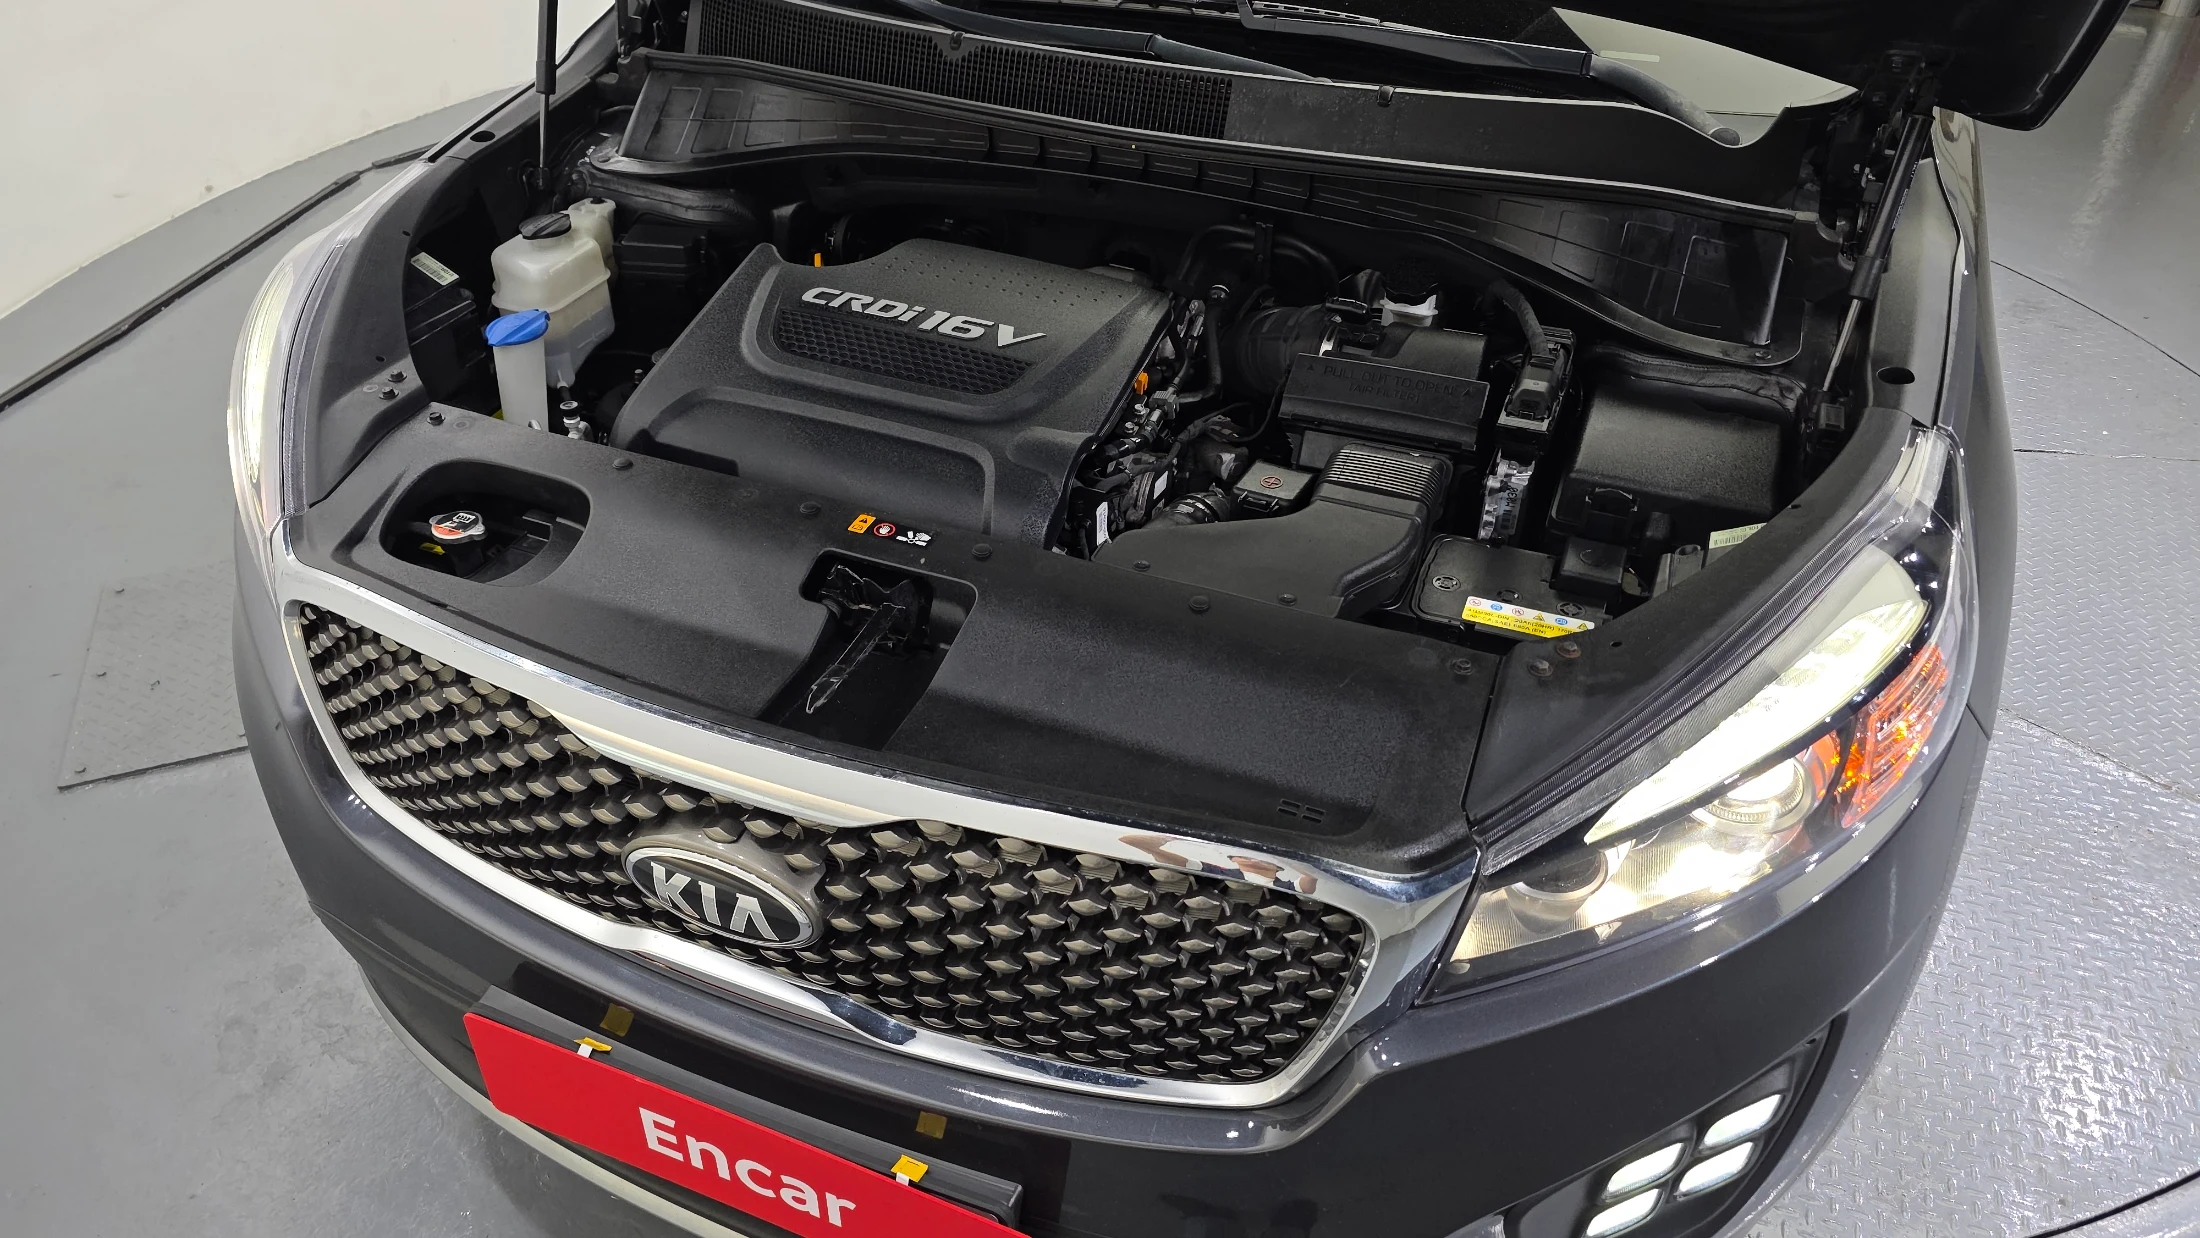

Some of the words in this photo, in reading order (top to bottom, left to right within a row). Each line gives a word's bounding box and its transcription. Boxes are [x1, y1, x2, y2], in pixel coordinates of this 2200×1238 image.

[802, 287, 926, 323] CRDi
[1323, 365, 1356, 380] PULL
[1361, 371, 1391, 385] OUT
[1393, 376, 1411, 388] TO
[1415, 379, 1454, 396] OPEN
[650, 861, 780, 942] KIA
[638, 1107, 857, 1228] Encar
